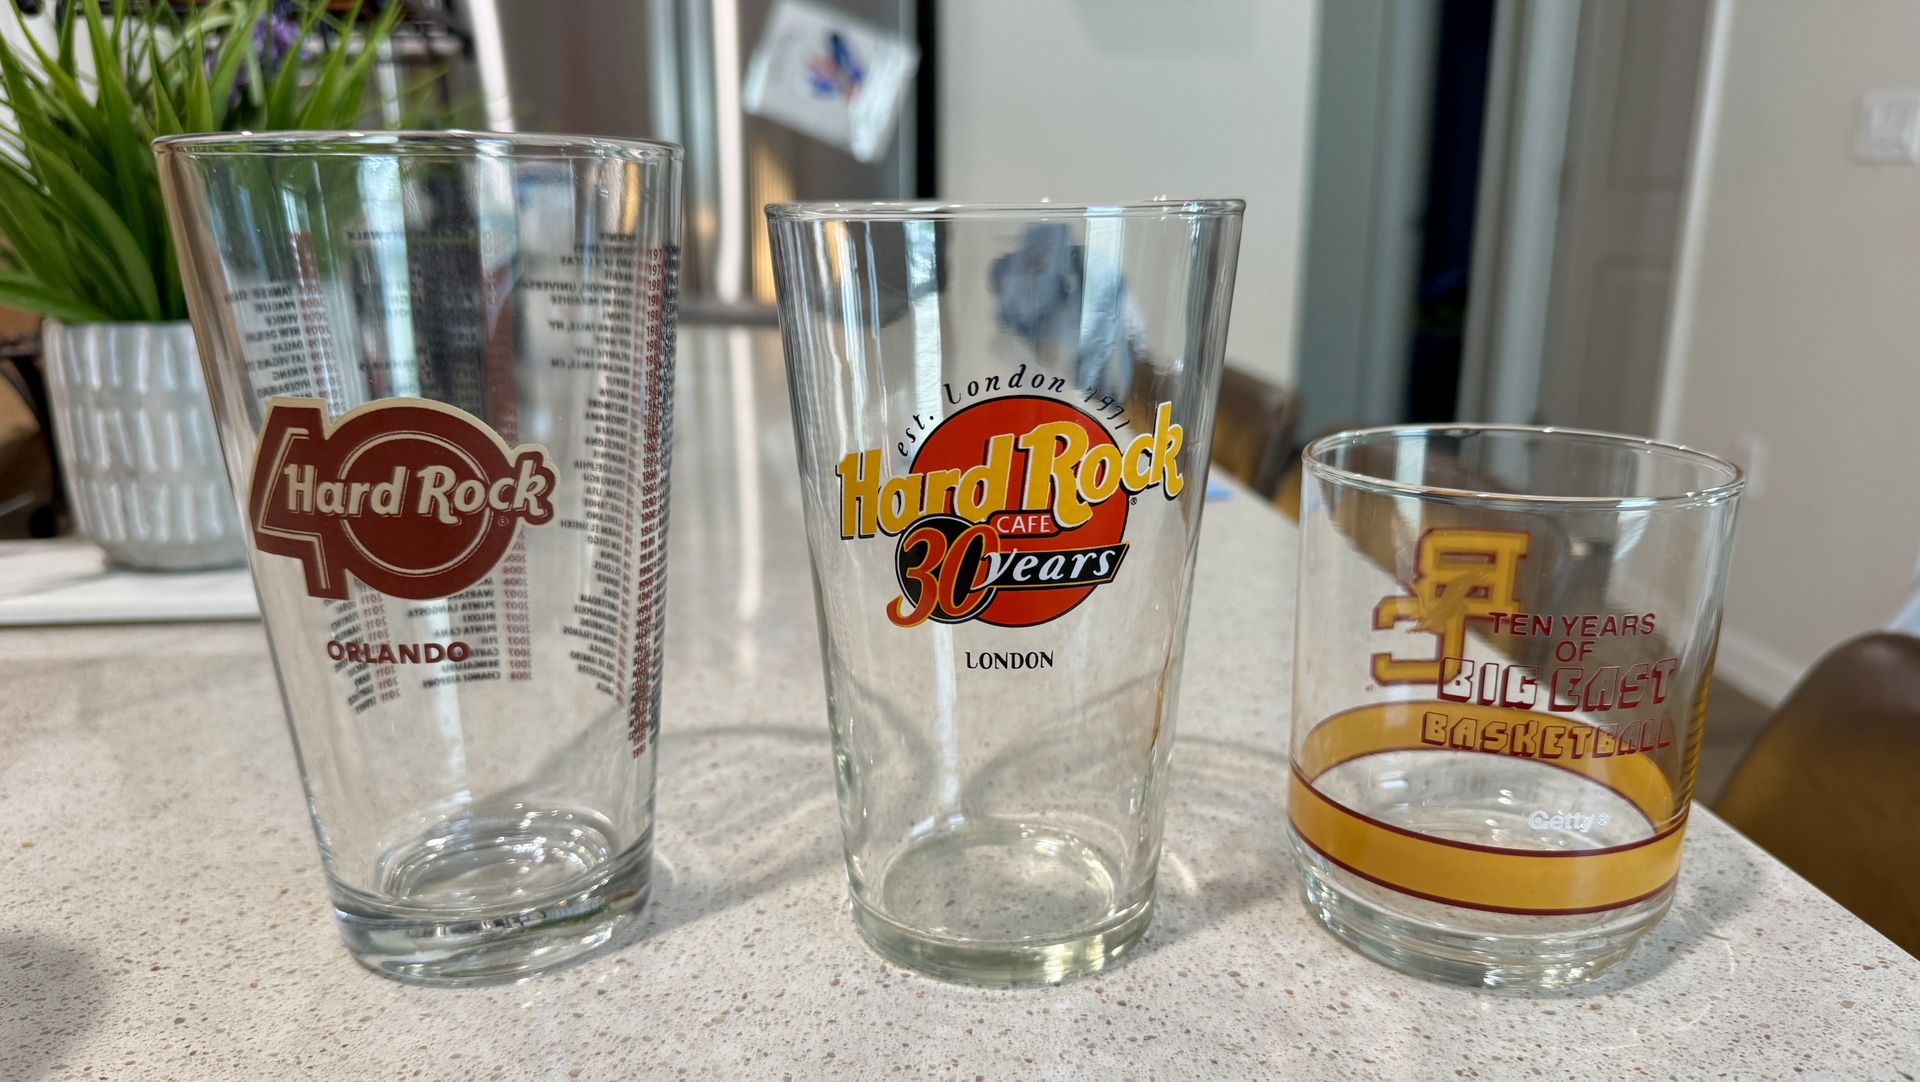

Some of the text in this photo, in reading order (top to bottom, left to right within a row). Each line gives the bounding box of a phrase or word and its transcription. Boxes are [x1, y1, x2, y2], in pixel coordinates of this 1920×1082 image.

[897, 364, 1131, 458] est. London 1971
[283, 459, 548, 526] Hard Rock
[835, 401, 1184, 540] Hard Rock
[996, 513, 1051, 534] CAFE
[886, 524, 1117, 628] 30 years
[1488, 612, 1656, 637] TEN YEARS
[327, 641, 472, 666] ORLANDO
[965, 649, 1054, 670] LONDON
[1555, 640, 1598, 663] OF
[1438, 657, 1678, 712] BIG EAST
[1422, 711, 1673, 760] BASKETBALL
